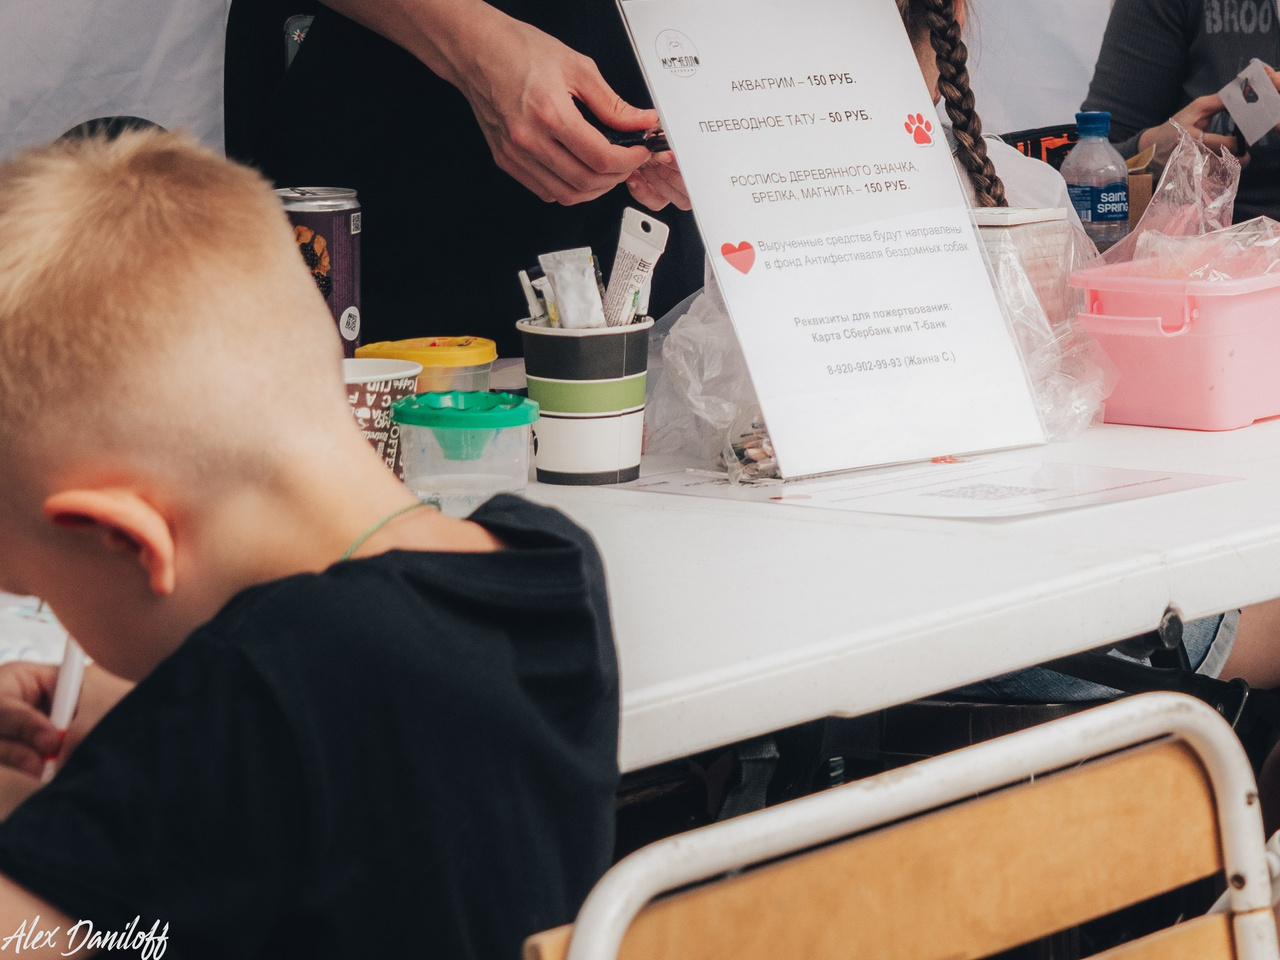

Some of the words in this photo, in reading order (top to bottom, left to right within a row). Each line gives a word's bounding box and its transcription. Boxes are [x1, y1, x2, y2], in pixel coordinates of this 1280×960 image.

[731, 76, 795, 92] АКВАГРИМ
[807, 74, 827, 86] 150
[828, 72, 857, 85] РУБ.
[698, 115, 785, 133] ПЕРЕВОДНОЕ
[785, 113, 816, 127] ТАТУ
[828, 111, 843, 123] 50
[844, 109, 873, 122] РУБ.
[730, 172, 788, 187] РОСПИСЬ
[789, 163, 872, 183] ДЕРЕВЯННОГО
[873, 160, 920, 174] ЗНАЧКА,
[751, 189, 800, 204] БРЕЛКА,
[800, 184, 853, 200] МАГНИТА
[863, 182, 883, 194] 150
[884, 179, 911, 192] РУБ.
[757, 237, 824, 253] Вырученные
[825, 233, 872, 249] средства
[873, 228, 902, 244] будут
[904, 224, 963, 240] направлены
[764, 260, 772, 270] в
[773, 256, 802, 271] фонд
[804, 248, 884, 266] Антифестиваля
[885, 243, 942, 258] бездомных
[943, 240, 970, 253] собак
[793, 314, 850, 328] Реквизиты
[852, 311, 871, 323] для
[872, 301, 953, 320] пожертвования:
[811, 331, 842, 344] Карта
[843, 324, 893, 340] Сбербанк
[893, 324, 913, 335] или
[913, 319, 947, 332] Т-банк
[826, 356, 903, 376] 8-920-902-99-93
[903, 354, 940, 369] (Жанна
